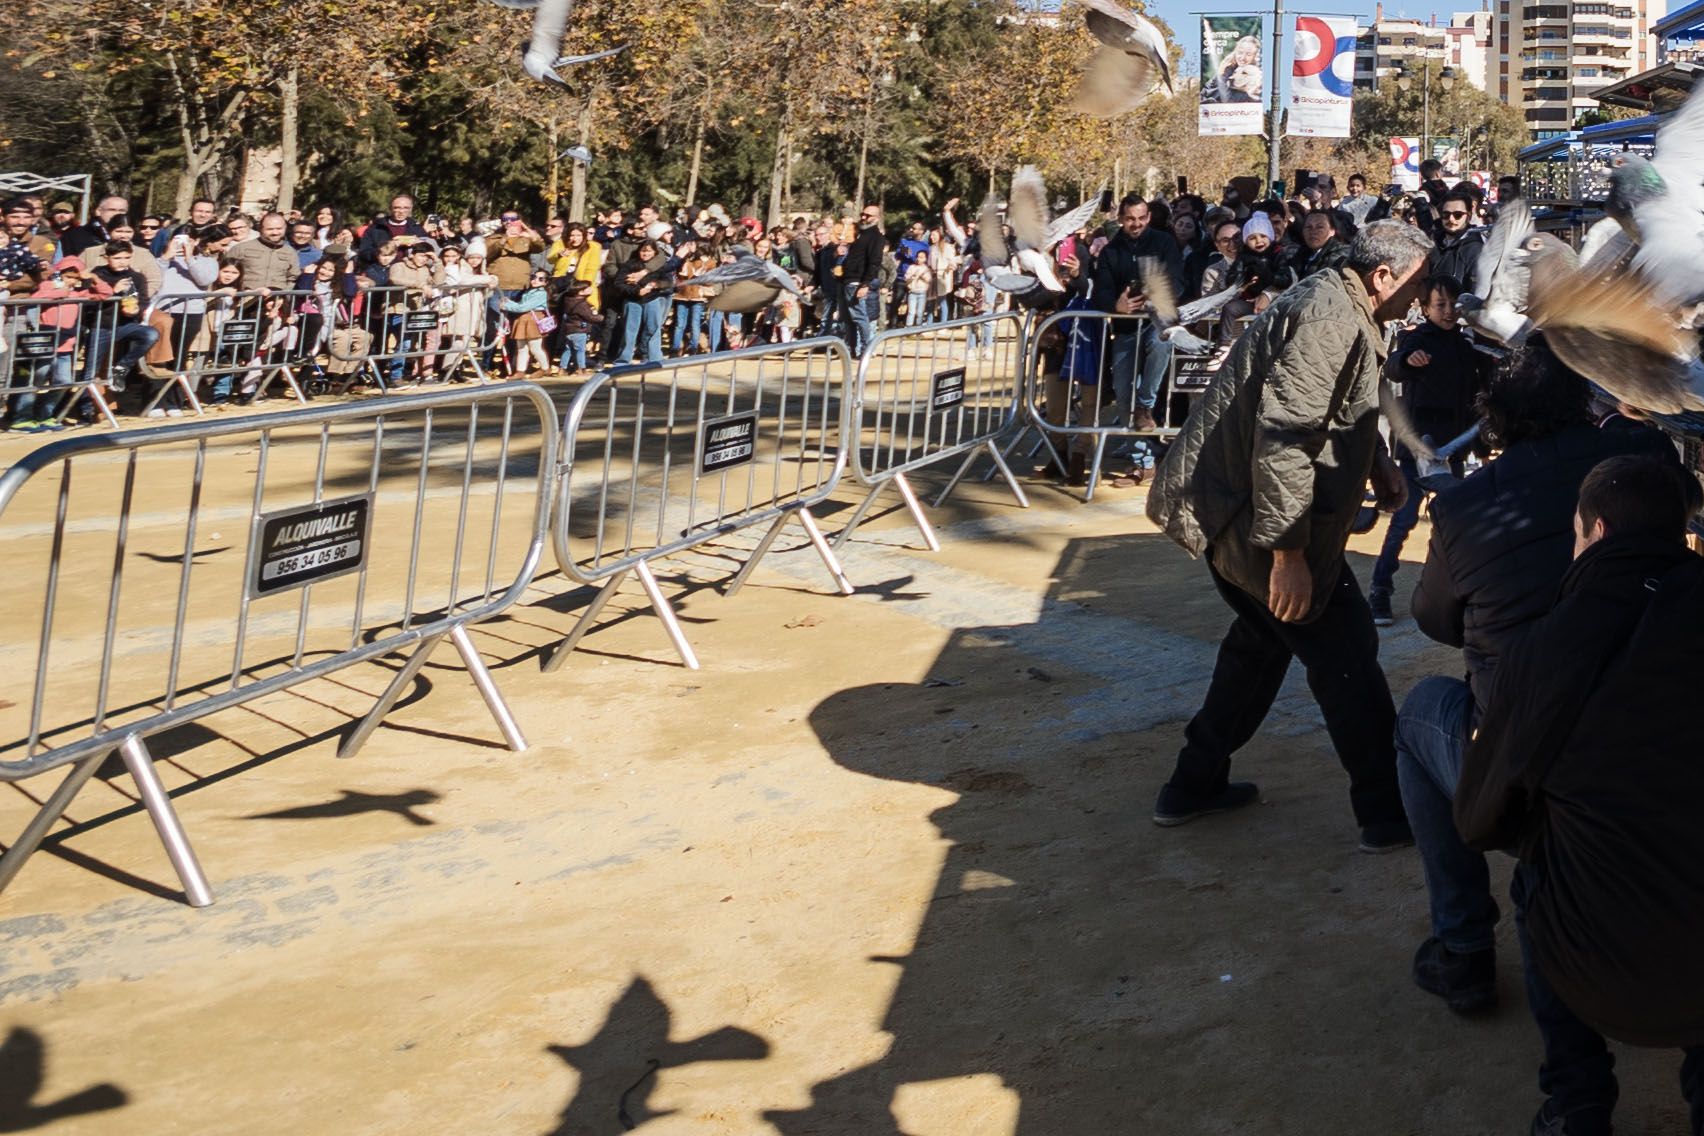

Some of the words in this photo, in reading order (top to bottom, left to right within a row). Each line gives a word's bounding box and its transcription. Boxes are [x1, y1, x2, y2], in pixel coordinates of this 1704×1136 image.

[272, 510, 358, 548] ALQUIVALLE
[277, 558, 299, 575] 956
[301, 553, 315, 568] 34
[318, 549, 332, 564] 05
[334, 545, 348, 560] 96
